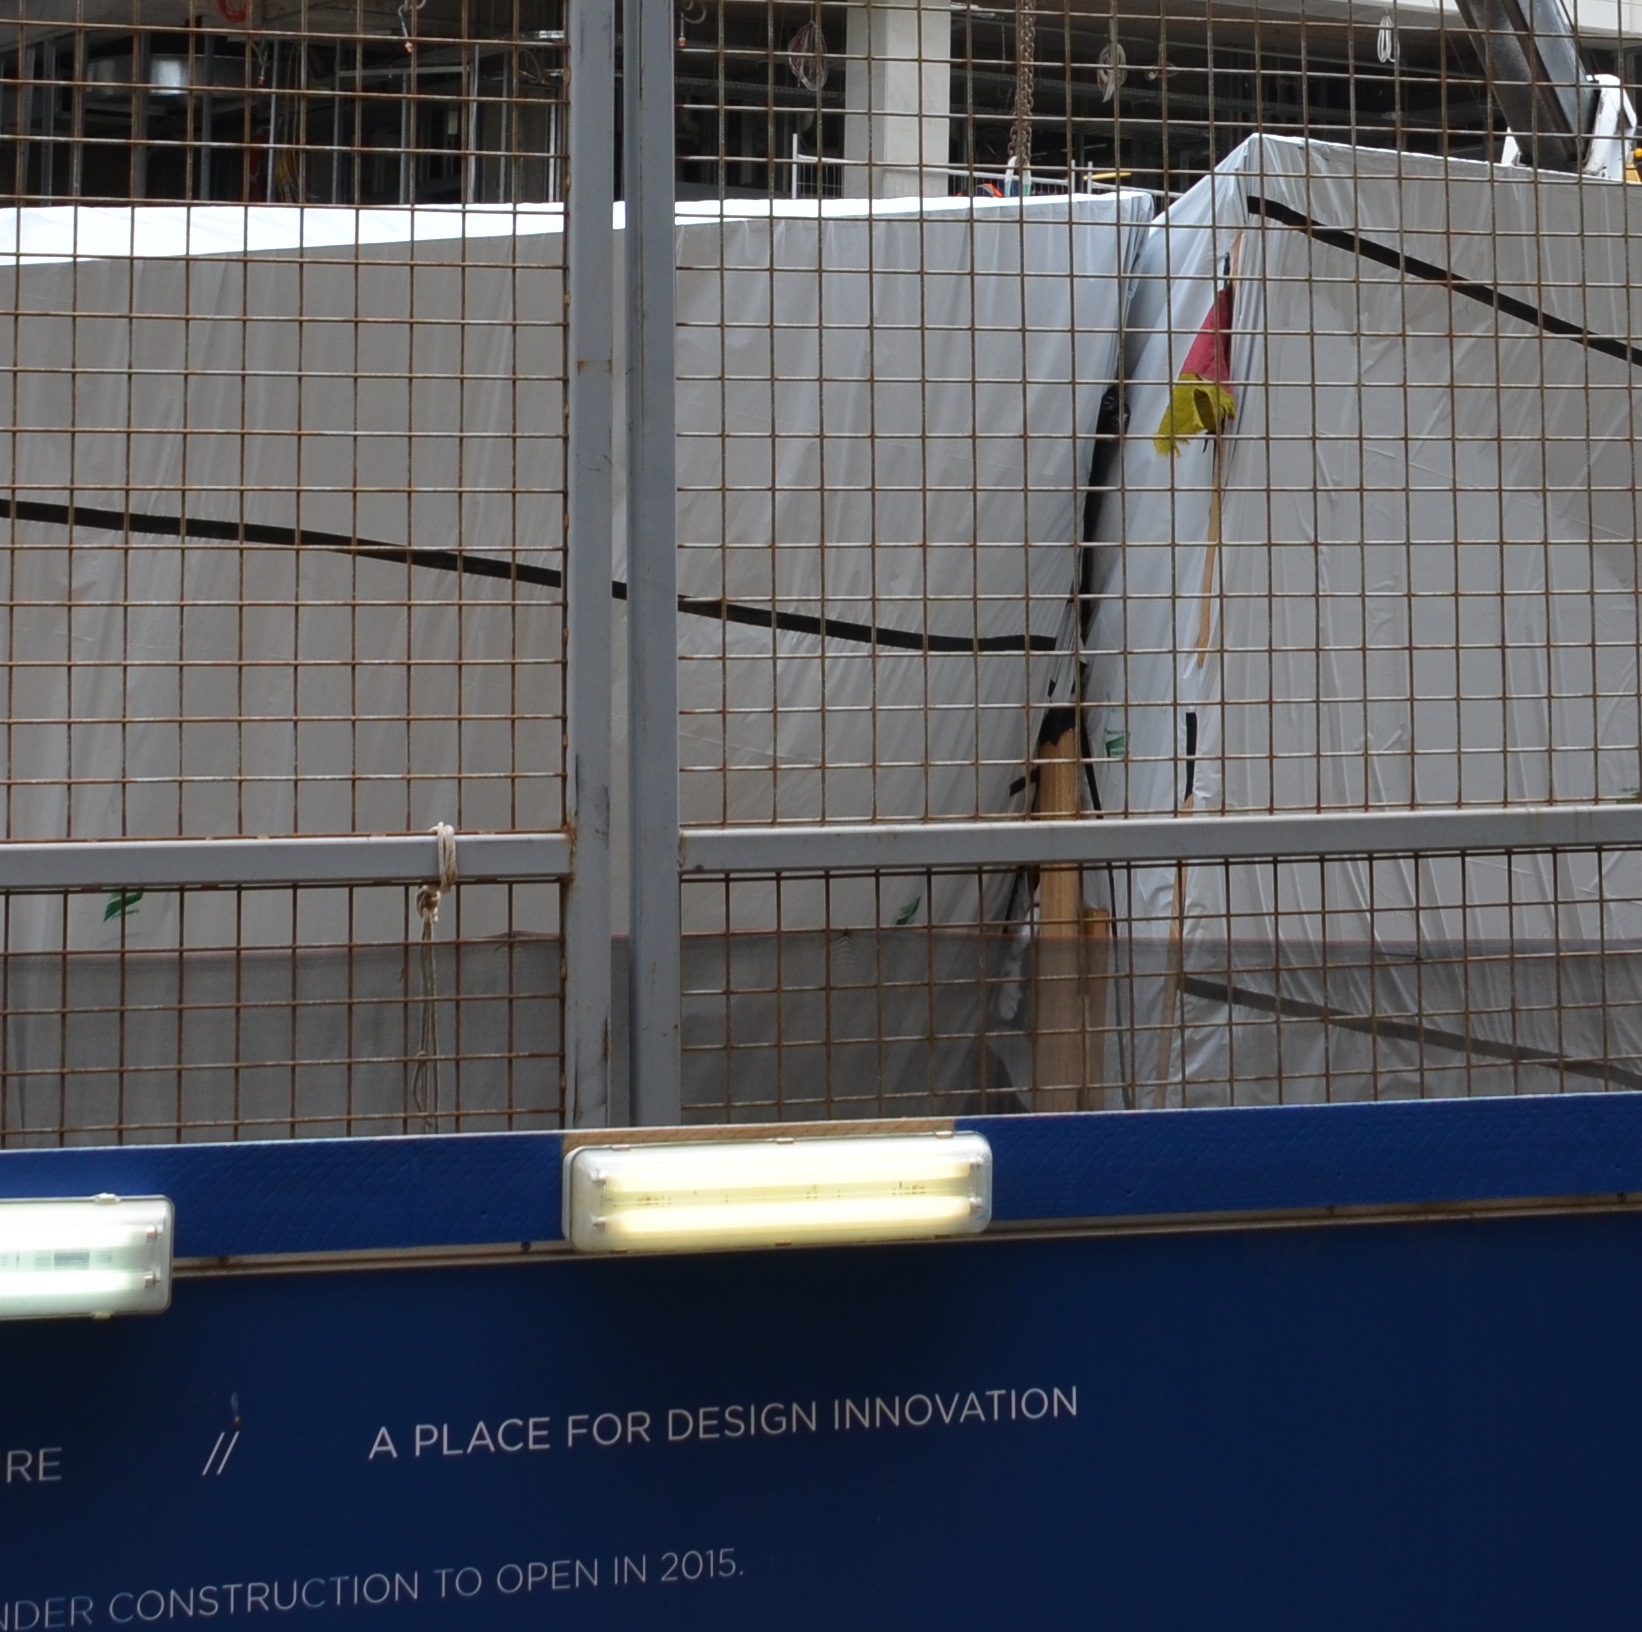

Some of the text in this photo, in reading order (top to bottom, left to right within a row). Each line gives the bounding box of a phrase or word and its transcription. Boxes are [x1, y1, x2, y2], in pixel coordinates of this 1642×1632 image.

[368, 1427, 398, 1461] A
[415, 1416, 550, 1457] PLACE
[567, 1411, 651, 1449] FOR
[667, 1401, 817, 1441] DESIGN
[833, 1385, 1079, 1432] INNOVATION
[109, 1570, 419, 1623] CONSTRUCTION
[434, 1563, 482, 1601] TO
[496, 1559, 599, 1596] OPEN
[612, 1554, 648, 1587] IN
[661, 1548, 745, 1584] 2015.
